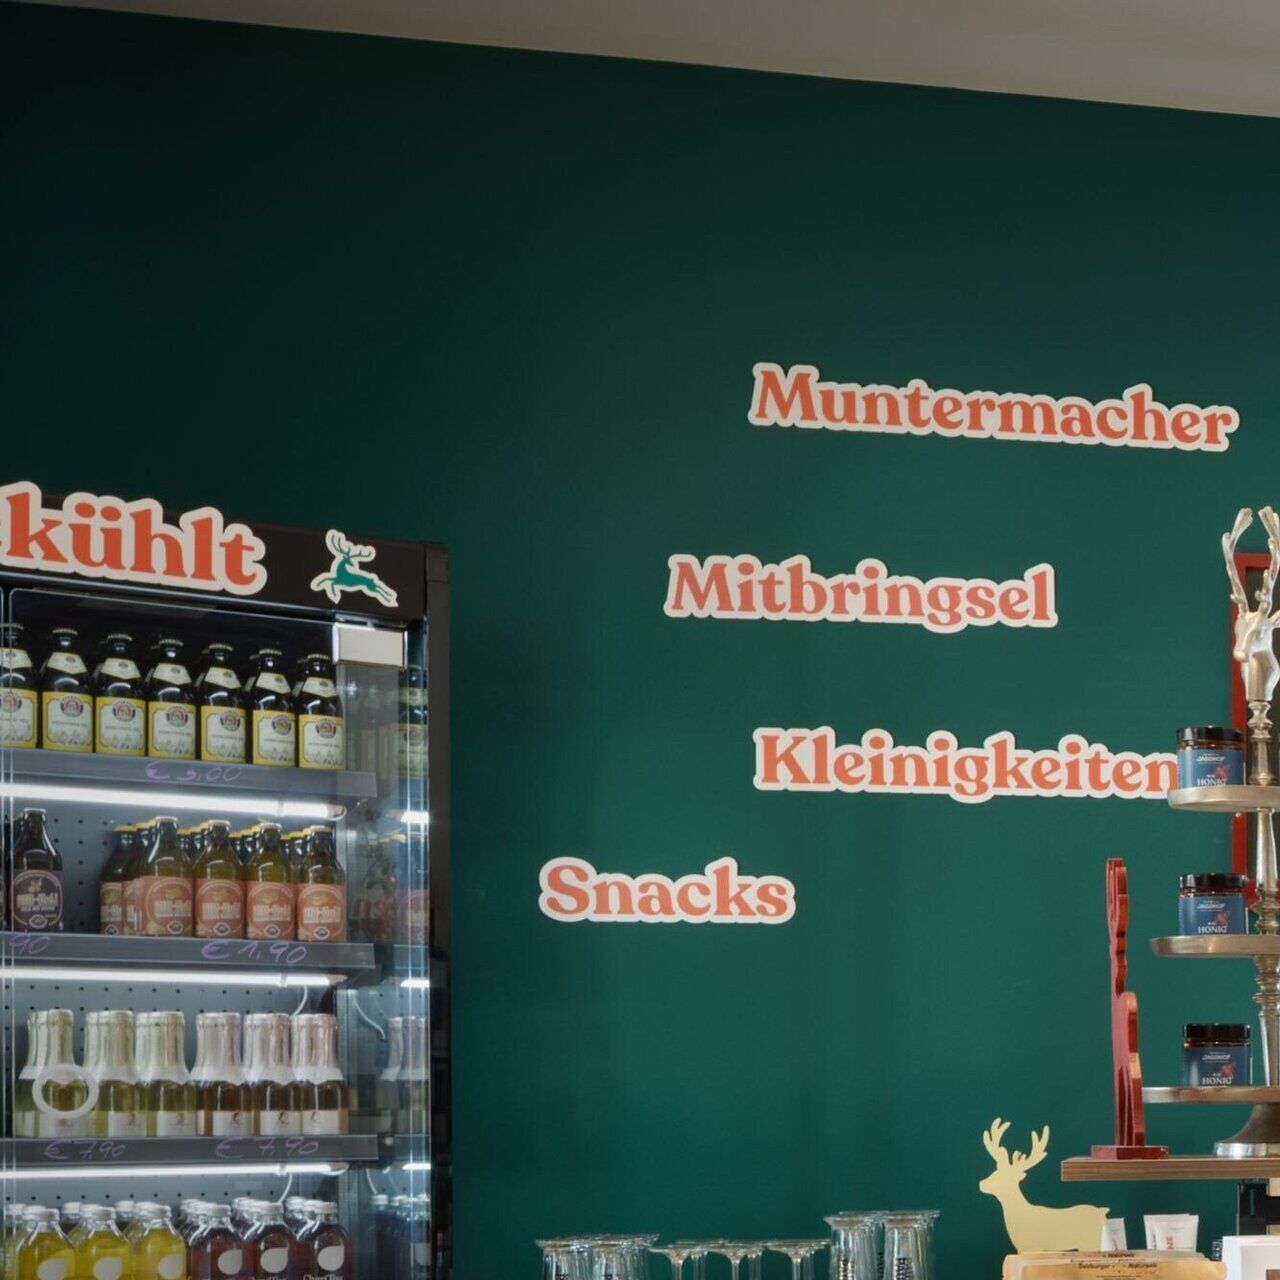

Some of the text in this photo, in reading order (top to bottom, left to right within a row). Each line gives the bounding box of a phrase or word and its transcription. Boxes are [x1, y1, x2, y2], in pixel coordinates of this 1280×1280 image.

[754, 370, 1232, 447] Muntermacher
[0, 492, 257, 586] kühlt
[670, 560, 1055, 627] Mitbringsel
[757, 733, 1178, 798] Kleinigkeiten
[547, 863, 789, 918] Snacks
[201, 939, 230, 959] €
[1202, 1077, 1232, 1085] HONIG
[44, 1140, 72, 1159] €
[215, 1139, 245, 1159] €
